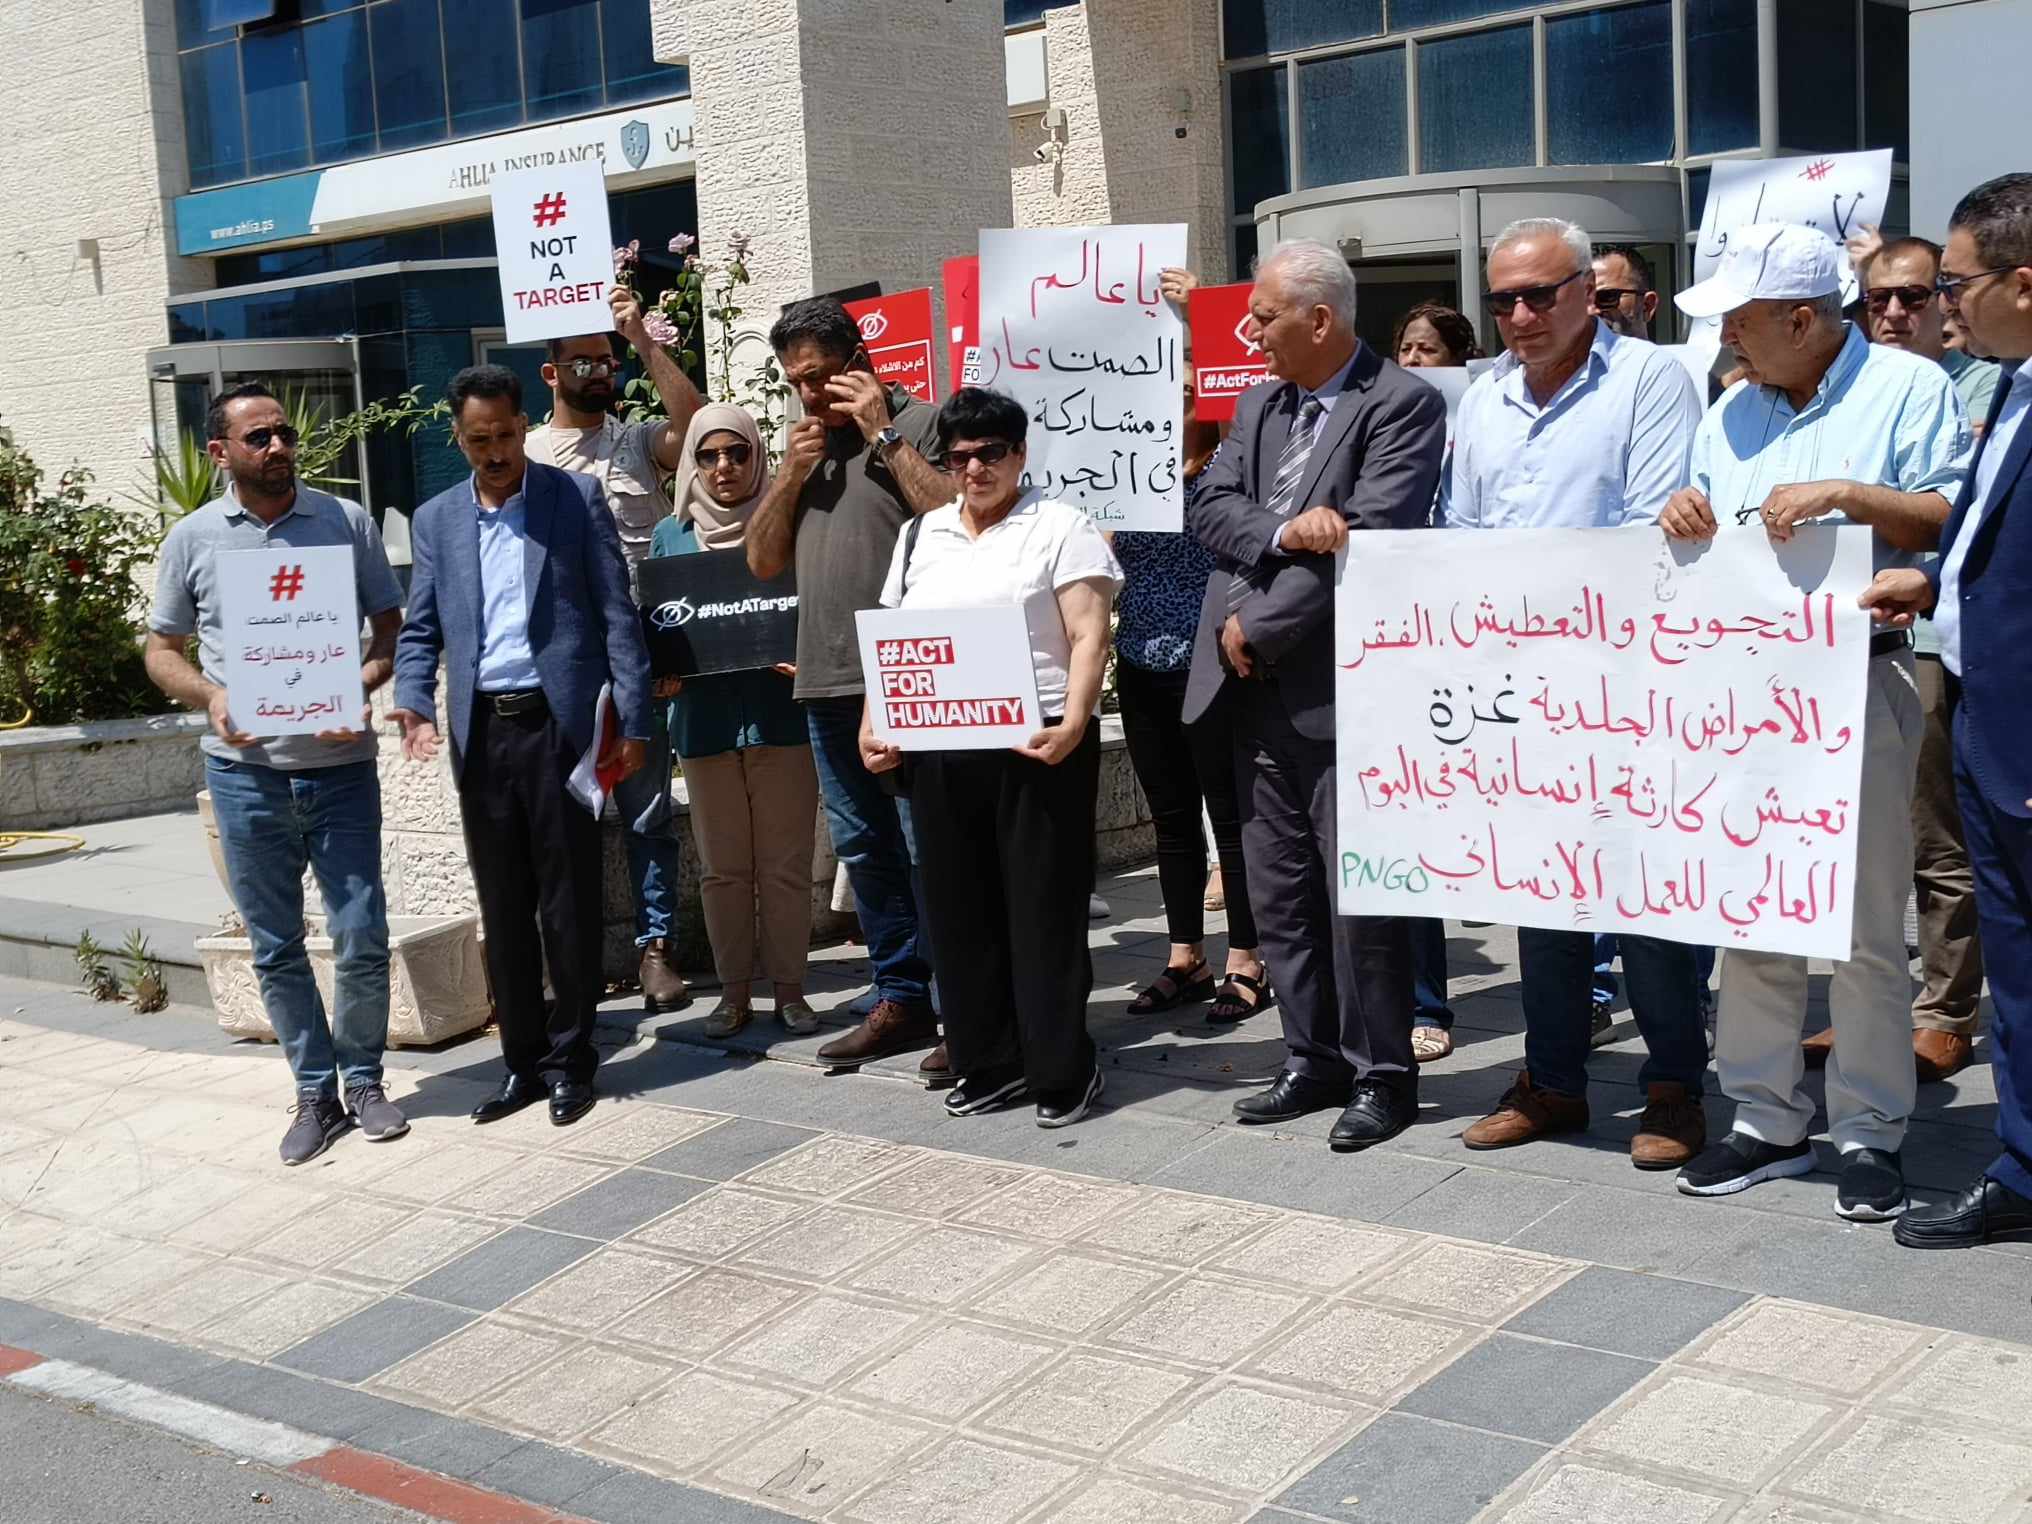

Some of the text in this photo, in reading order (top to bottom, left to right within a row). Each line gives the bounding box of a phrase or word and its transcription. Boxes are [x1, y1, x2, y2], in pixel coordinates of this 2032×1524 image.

[532, 191, 567, 228] #
[530, 236, 577, 259] NOT
[549, 263, 566, 281] A
[1031, 239, 1161, 321] يا عالم
[513, 281, 605, 310] TARGET
[982, 315, 1175, 386] الصمت عار
[964, 368, 980, 381] FO
[1032, 388, 1173, 442] ومشاركة
[1019, 446, 1177, 502] في الجريم
[268, 564, 305, 602] #
[247, 613, 292, 627] الصمت
[296, 611, 326, 630] عالم
[697, 595, 799, 619] #NotATarge
[1336, 602, 1433, 669] الفقر
[1650, 591, 1835, 665] التجويع
[243, 643, 346, 666] عار ومشاركة
[879, 638, 950, 665] #ACT
[284, 668, 303, 689] في
[882, 671, 934, 696] FOR
[256, 694, 343, 722] الجريمة
[887, 699, 1022, 727] HUMANITY
[1429, 673, 1851, 755] والأمراض الجلدية غزة
[1357, 735, 1849, 848] تعيش كارثة إنسانية في اليوم
[1341, 851, 1429, 893] PNGO
[1615, 851, 1706, 919] للعمل
[1718, 852, 1838, 938] العالمي
